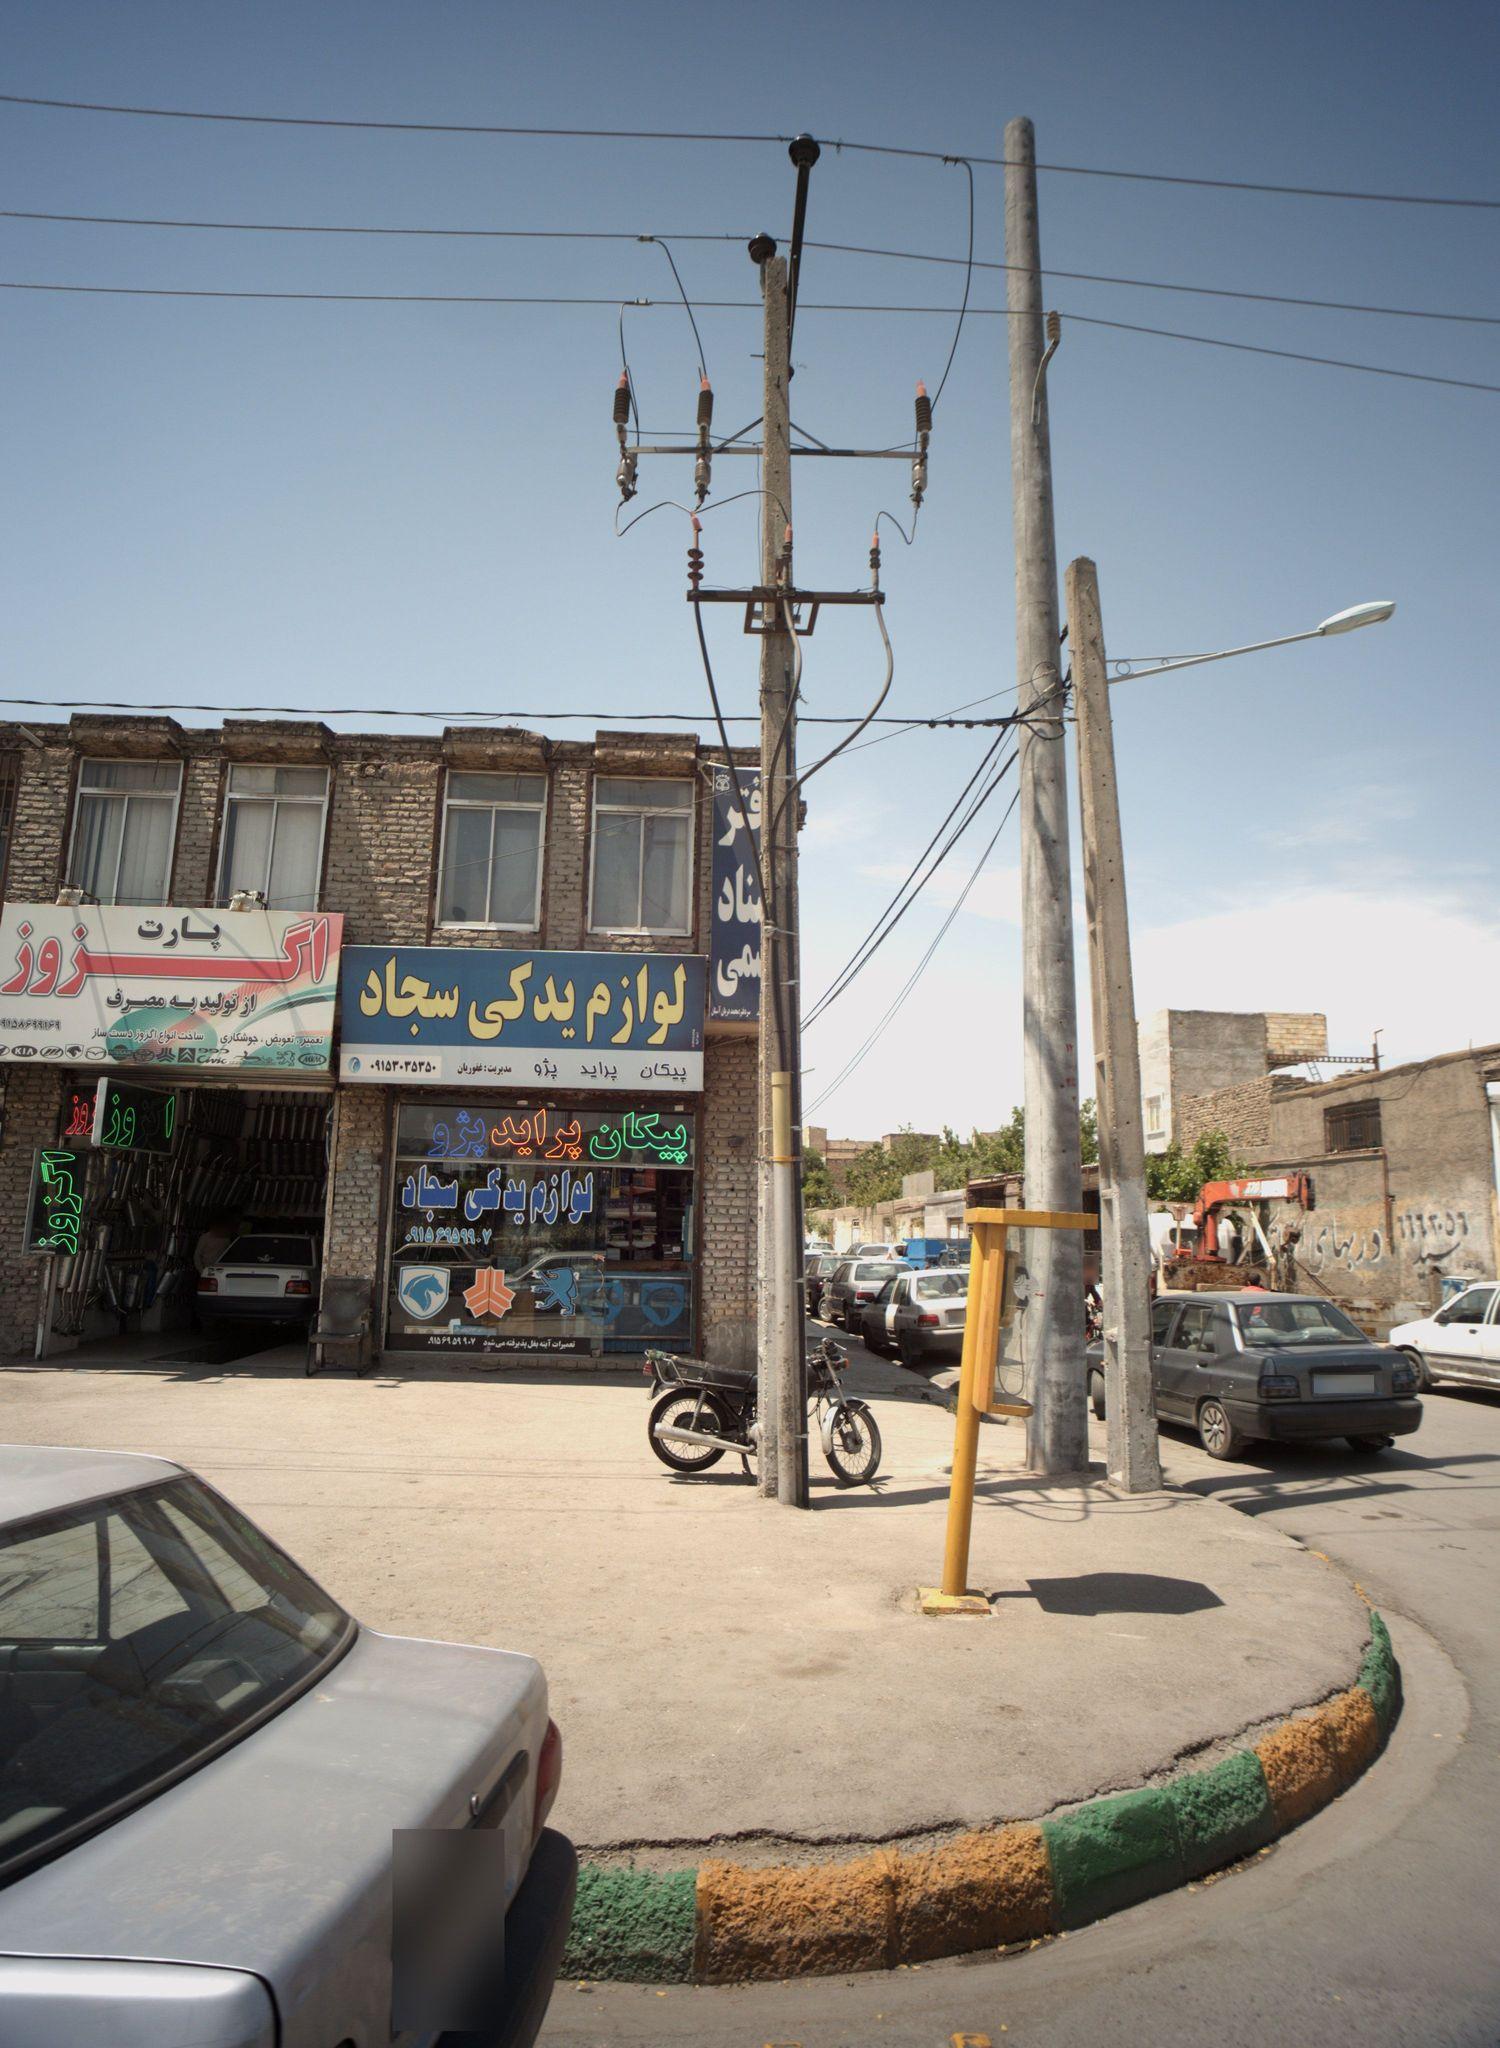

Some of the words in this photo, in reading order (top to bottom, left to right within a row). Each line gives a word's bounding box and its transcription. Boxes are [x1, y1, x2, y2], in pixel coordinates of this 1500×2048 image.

[717, 775, 762, 846] فتر
[137, 916, 221, 948] پارت
[1, 917, 329, 997] اگزوز
[106, 987, 166, 1014] مصرف
[169, 993, 196, 1015] به
[199, 991, 240, 1016] تولید
[242, 993, 257, 1017] از
[359, 955, 461, 1037] سجاد
[468, 960, 575, 1040] یدکی
[585, 962, 687, 1046] لوازم
[91, 1027, 108, 1040] ساز
[134, 1028, 157, 1043] اگزوز
[157, 1030, 177, 1044] انواع
[178, 1030, 205, 1041] ساخت
[14, 1047, 35, 1056] KIA
[533, 1057, 559, 1080] پژو
[579, 1060, 618, 1081] پراید
[639, 1061, 688, 1083] پیکان
[427, 1110, 488, 1159] پژو
[490, 1108, 583, 1160] پراید
[589, 1111, 688, 1165] پیکان
[38, 1151, 83, 1255] اگزوز
[402, 1164, 459, 1223] سجاد
[464, 1167, 526, 1224] یدکی
[530, 1169, 594, 1225] لوازم
